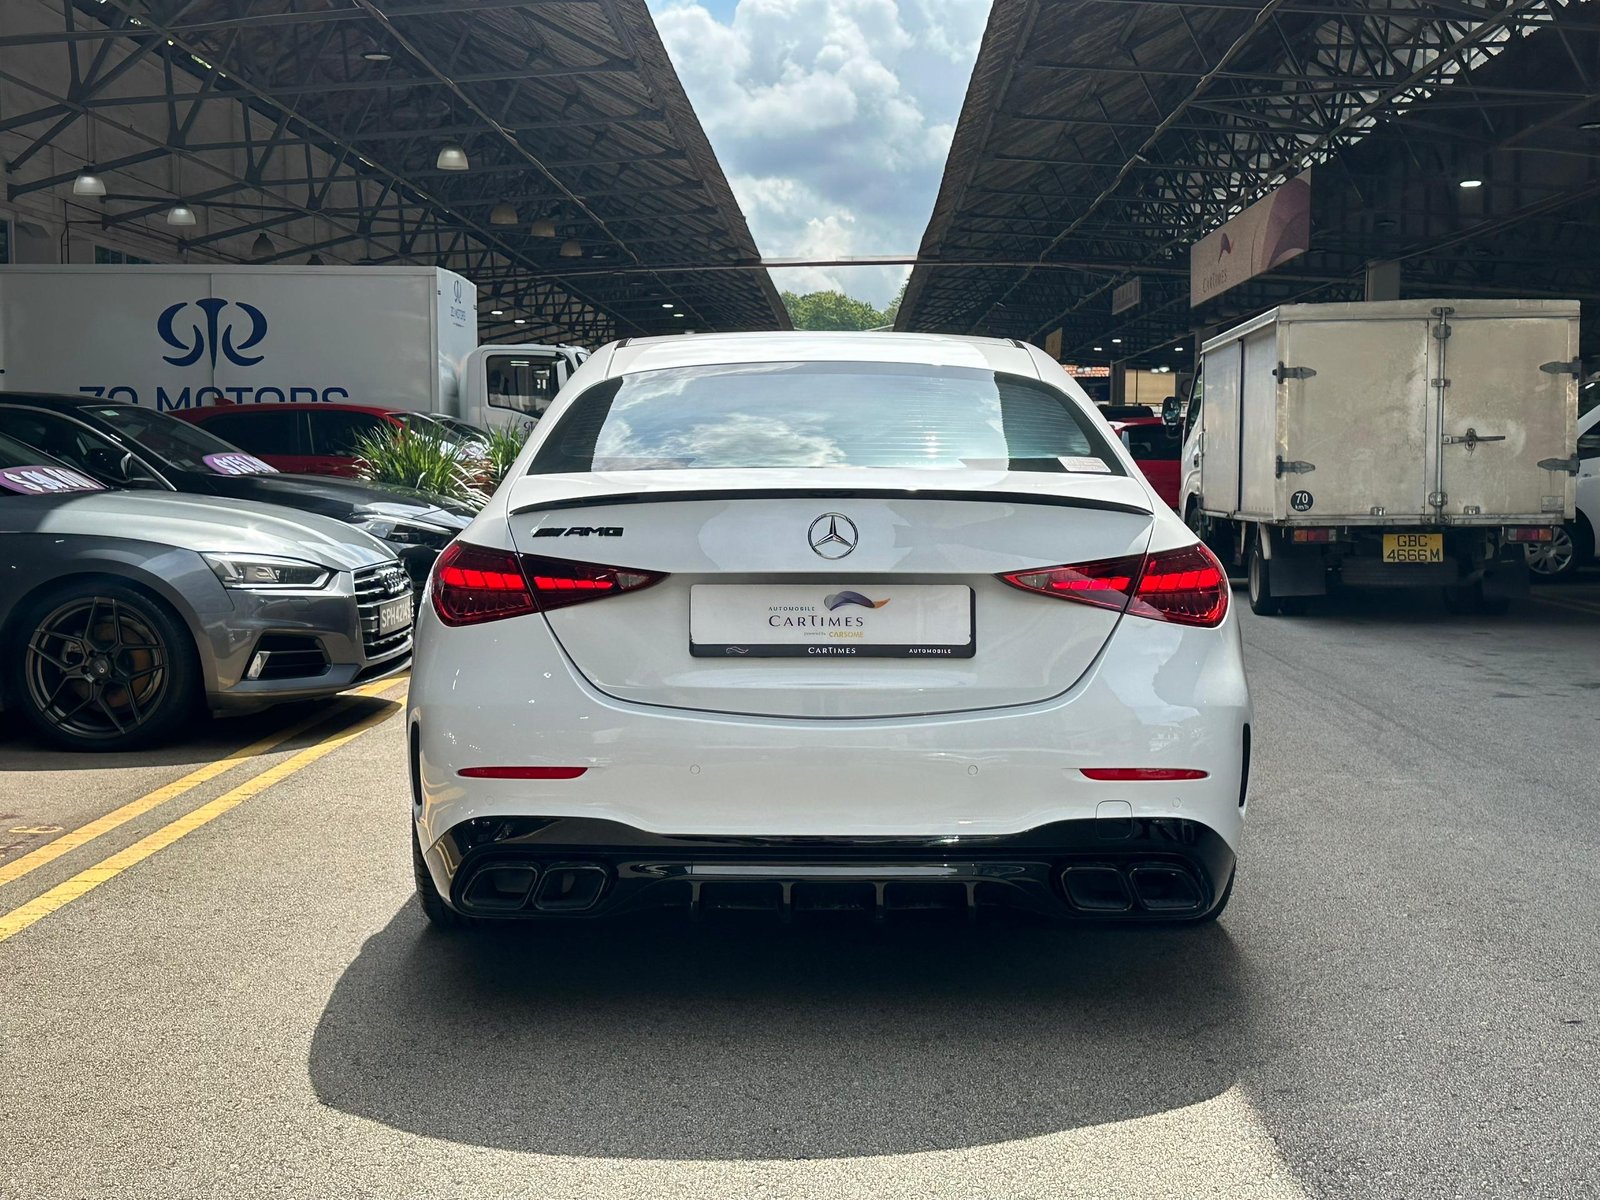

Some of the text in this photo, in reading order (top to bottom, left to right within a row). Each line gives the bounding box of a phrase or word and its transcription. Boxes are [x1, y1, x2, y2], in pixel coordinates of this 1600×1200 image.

[1295, 493, 1309, 504] 70
[563, 527, 624, 537] AMG
[1397, 534, 1428, 547] GBC
